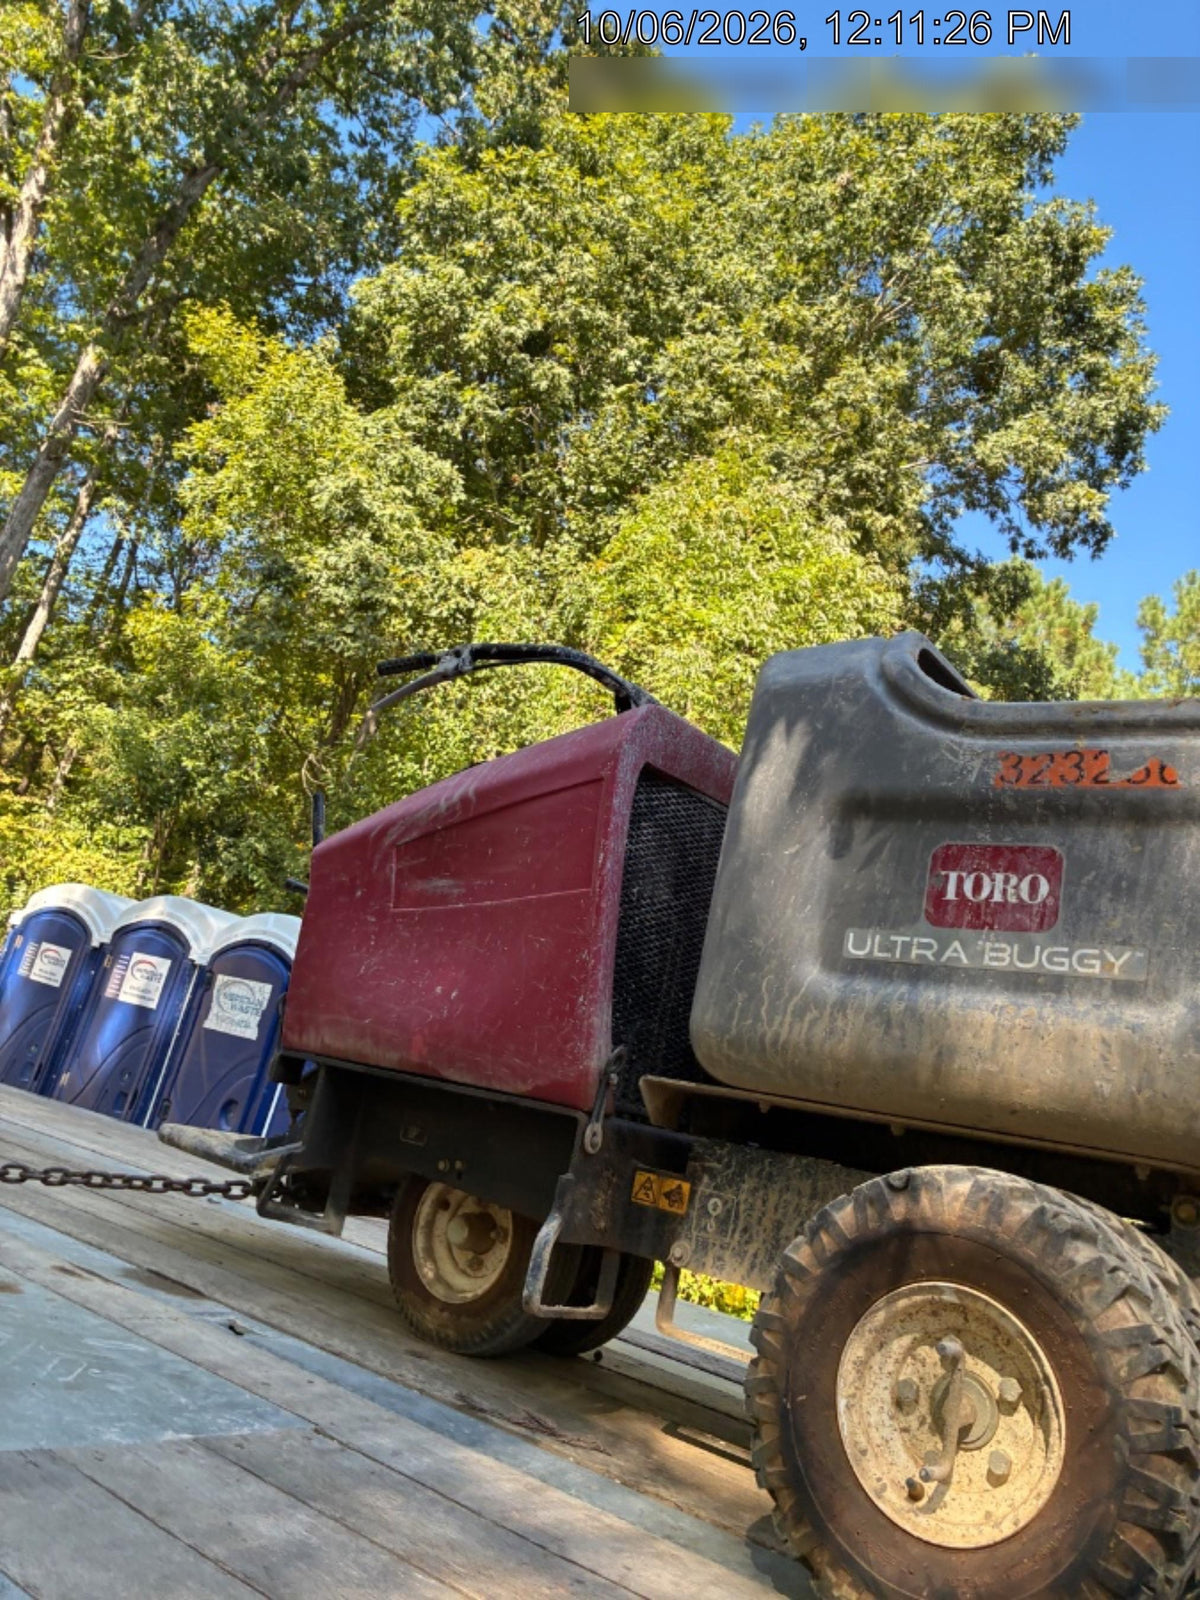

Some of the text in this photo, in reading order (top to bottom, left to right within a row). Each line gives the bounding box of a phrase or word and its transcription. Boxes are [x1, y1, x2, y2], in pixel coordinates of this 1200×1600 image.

[940, 870, 1051, 904] TORO
[848, 932, 1133, 975] ULTRA BUGGY
